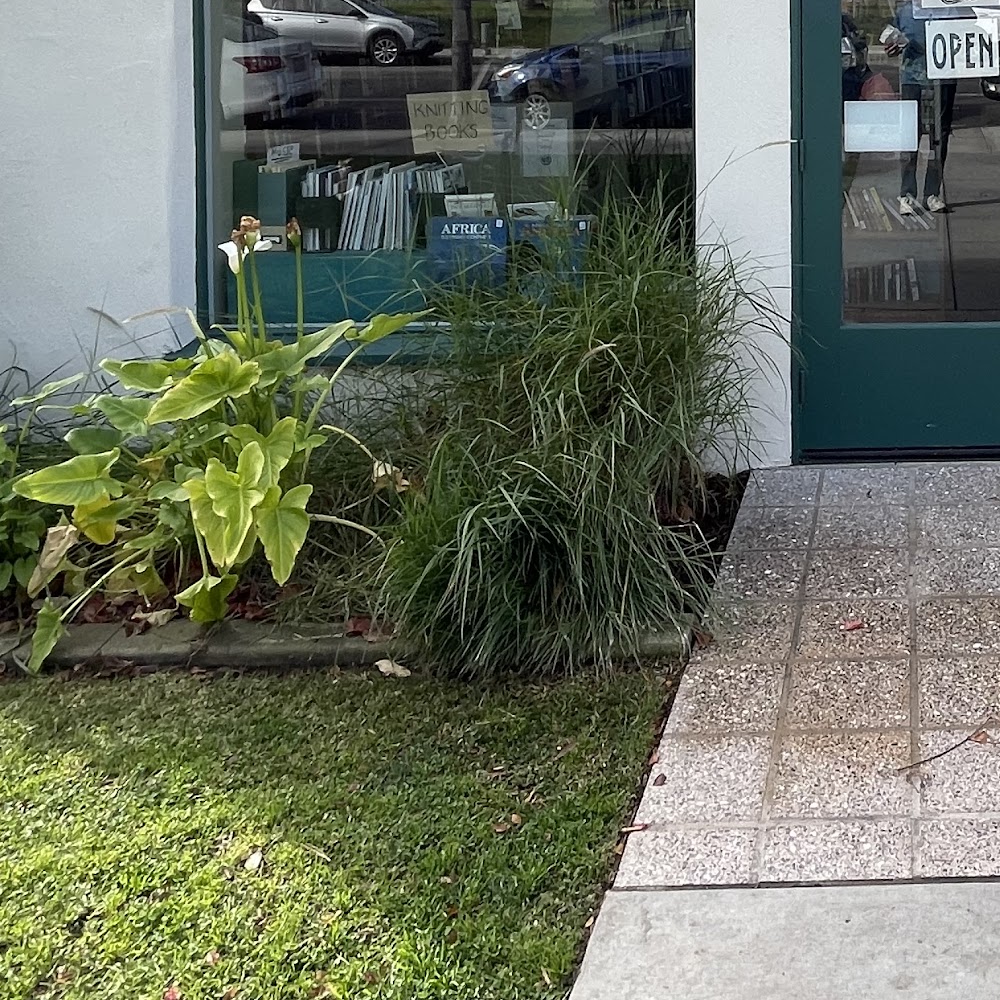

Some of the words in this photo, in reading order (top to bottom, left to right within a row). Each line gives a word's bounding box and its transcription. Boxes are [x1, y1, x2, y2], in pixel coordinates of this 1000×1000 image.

[931, 31, 995, 71] OPEN
[412, 99, 490, 118] KNITTING
[423, 123, 479, 142] BOOKS
[440, 222, 492, 235] AFRICA
